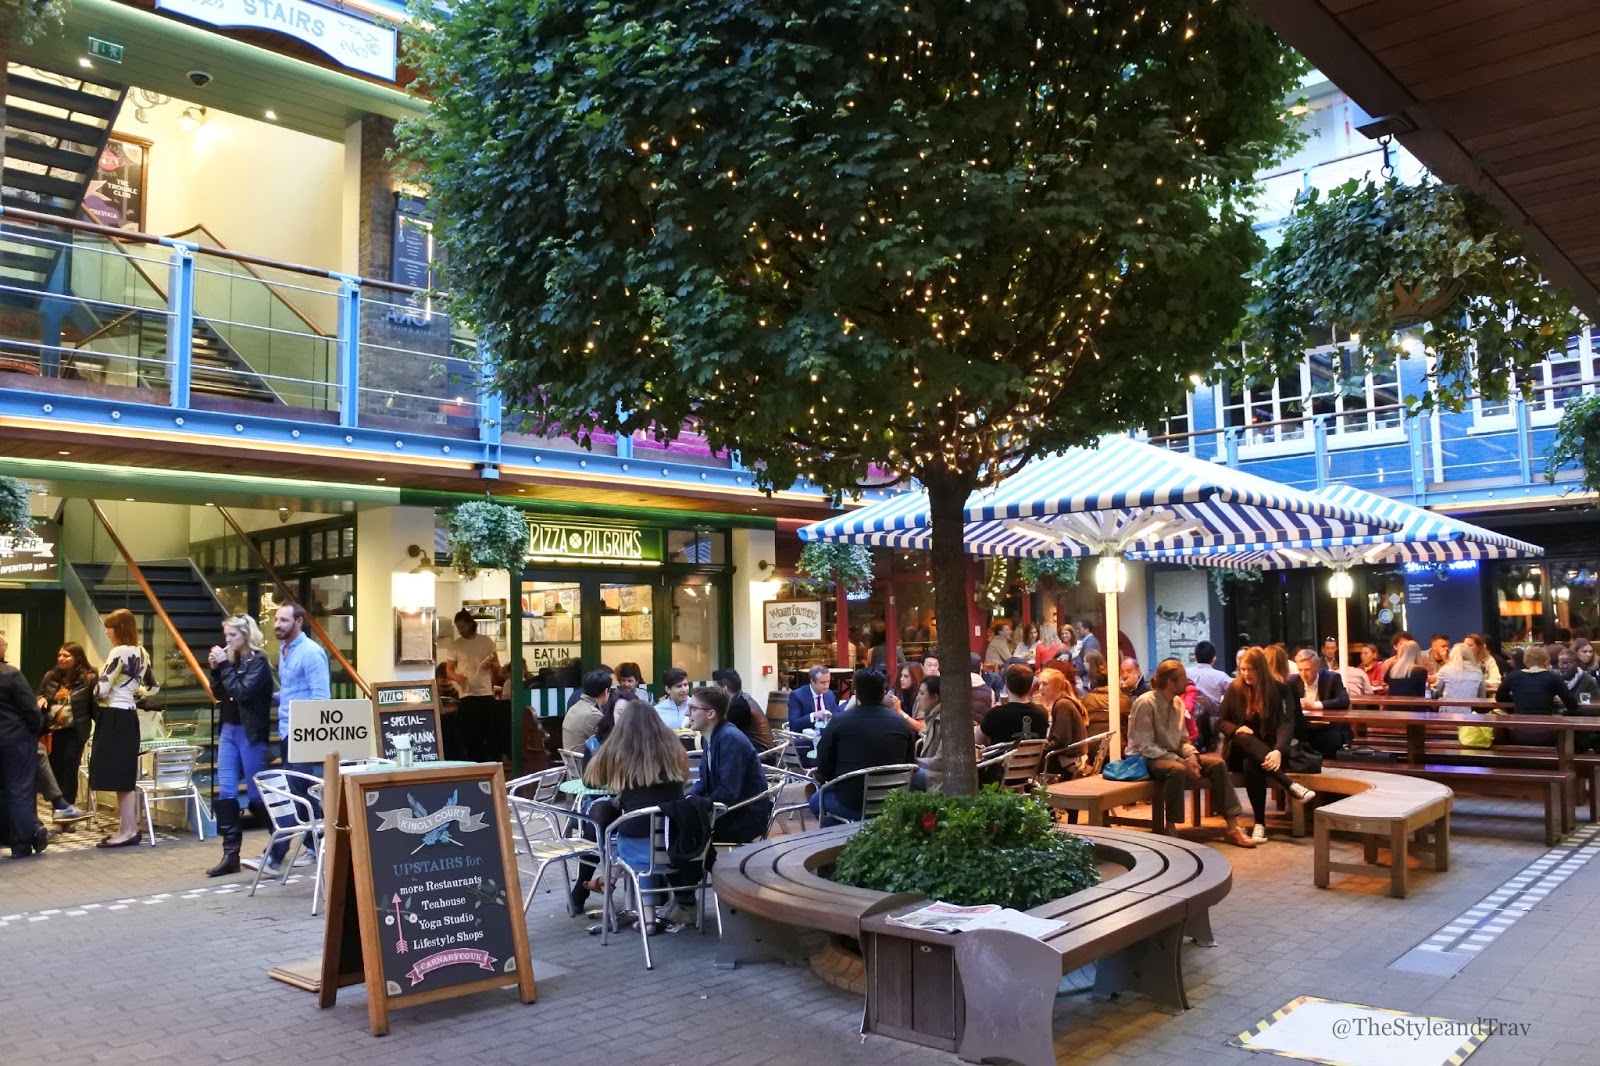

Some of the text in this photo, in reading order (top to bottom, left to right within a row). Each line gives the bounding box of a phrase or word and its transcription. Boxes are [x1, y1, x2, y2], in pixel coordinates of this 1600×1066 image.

[243, 0, 326, 37] STAIRS
[107, 182, 138, 195] TROUBLE
[116, 179, 130, 187] THE
[113, 190, 131, 199] CLUB
[88, 208, 118, 219] TRIYOGA
[530, 523, 642, 557] PIZZA PILGRIMS
[33, 563, 47, 571] BAR
[534, 648, 569, 659] EAT IN
[379, 691, 396, 702] PIZZA
[320, 710, 343, 724] NO
[293, 726, 368, 742] SMOKING
[401, 809, 466, 831] KINGLY COURT
[393, 857, 463, 876] UPSTAIRS
[400, 875, 482, 895] more Restaurants
[422, 897, 466, 910] Teahouse
[418, 913, 474, 930] Yoga Studio
[413, 930, 484, 949] Lifestyle Shops
